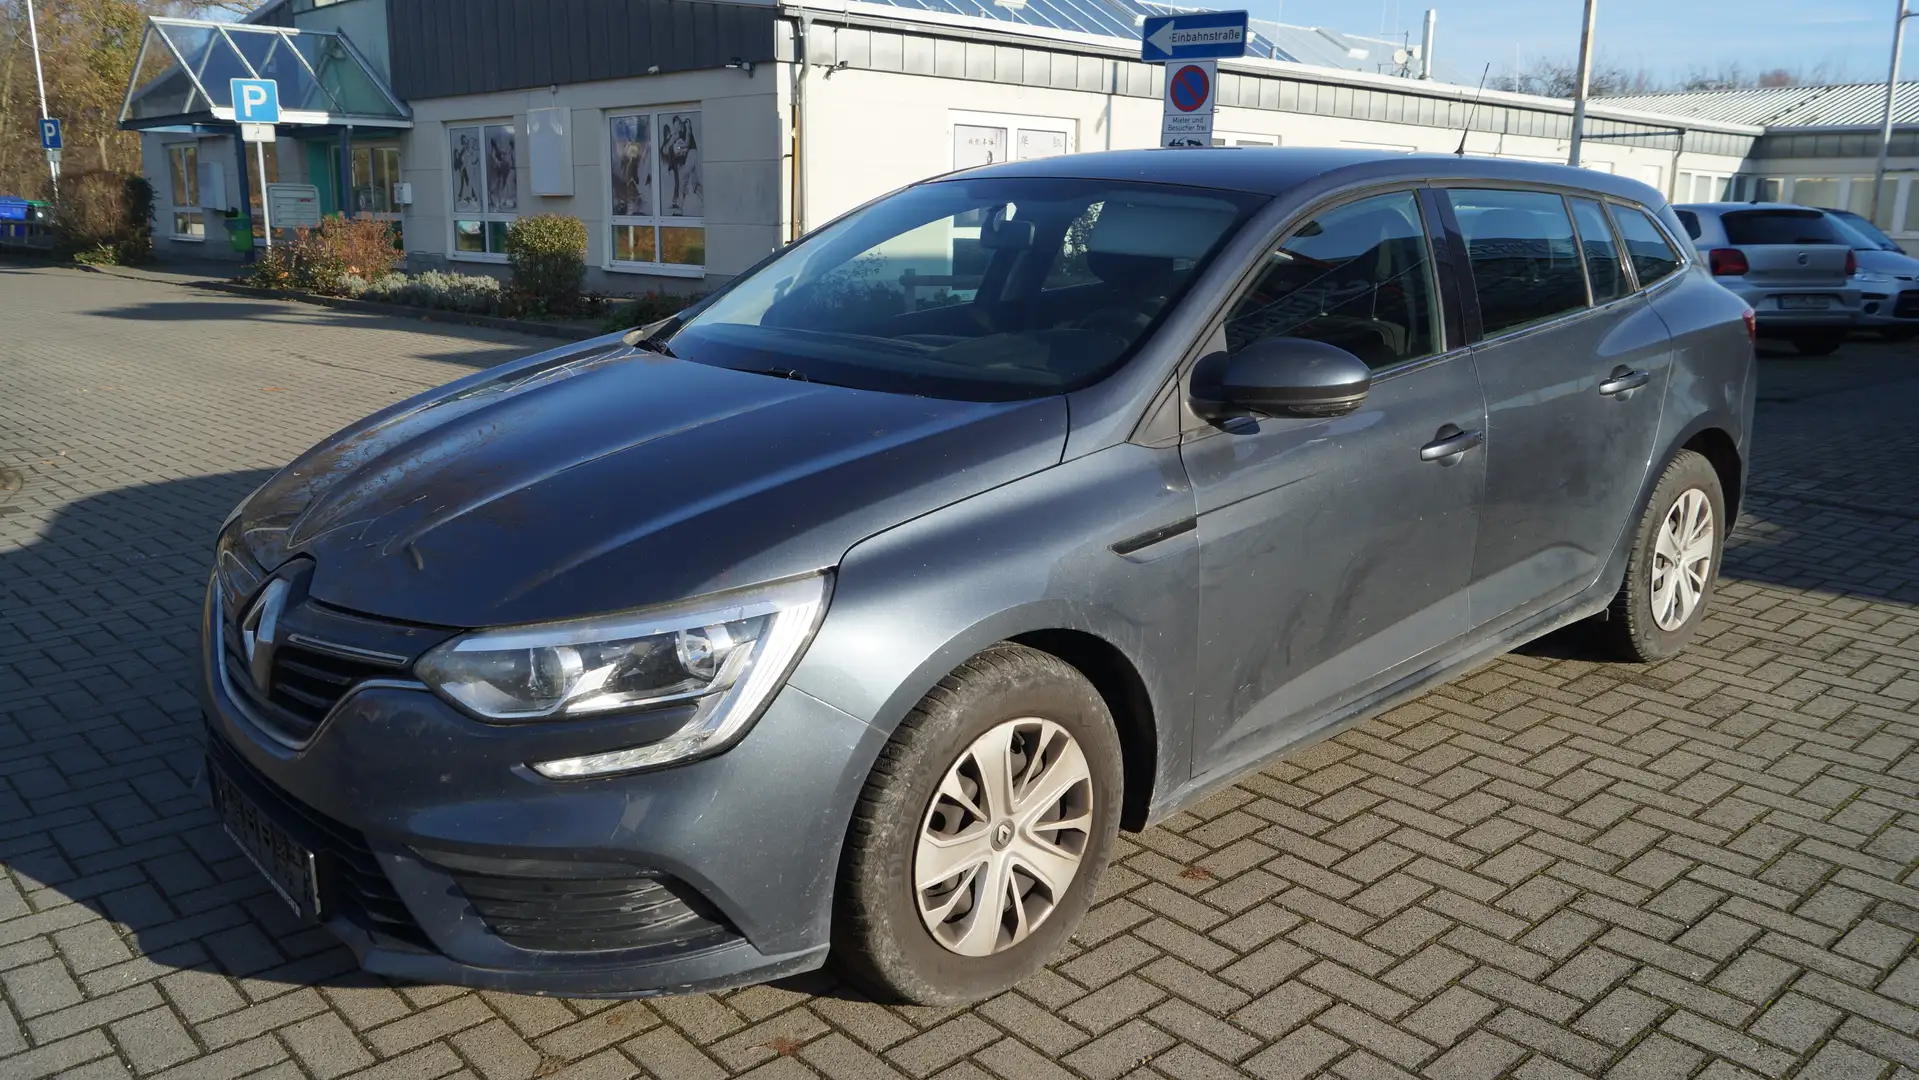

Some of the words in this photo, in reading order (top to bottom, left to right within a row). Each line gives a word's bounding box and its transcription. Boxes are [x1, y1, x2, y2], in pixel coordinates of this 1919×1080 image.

[1171, 30, 1240, 42] Einbahnstraße
[242, 85, 267, 117] P
[43, 122, 56, 146] P
